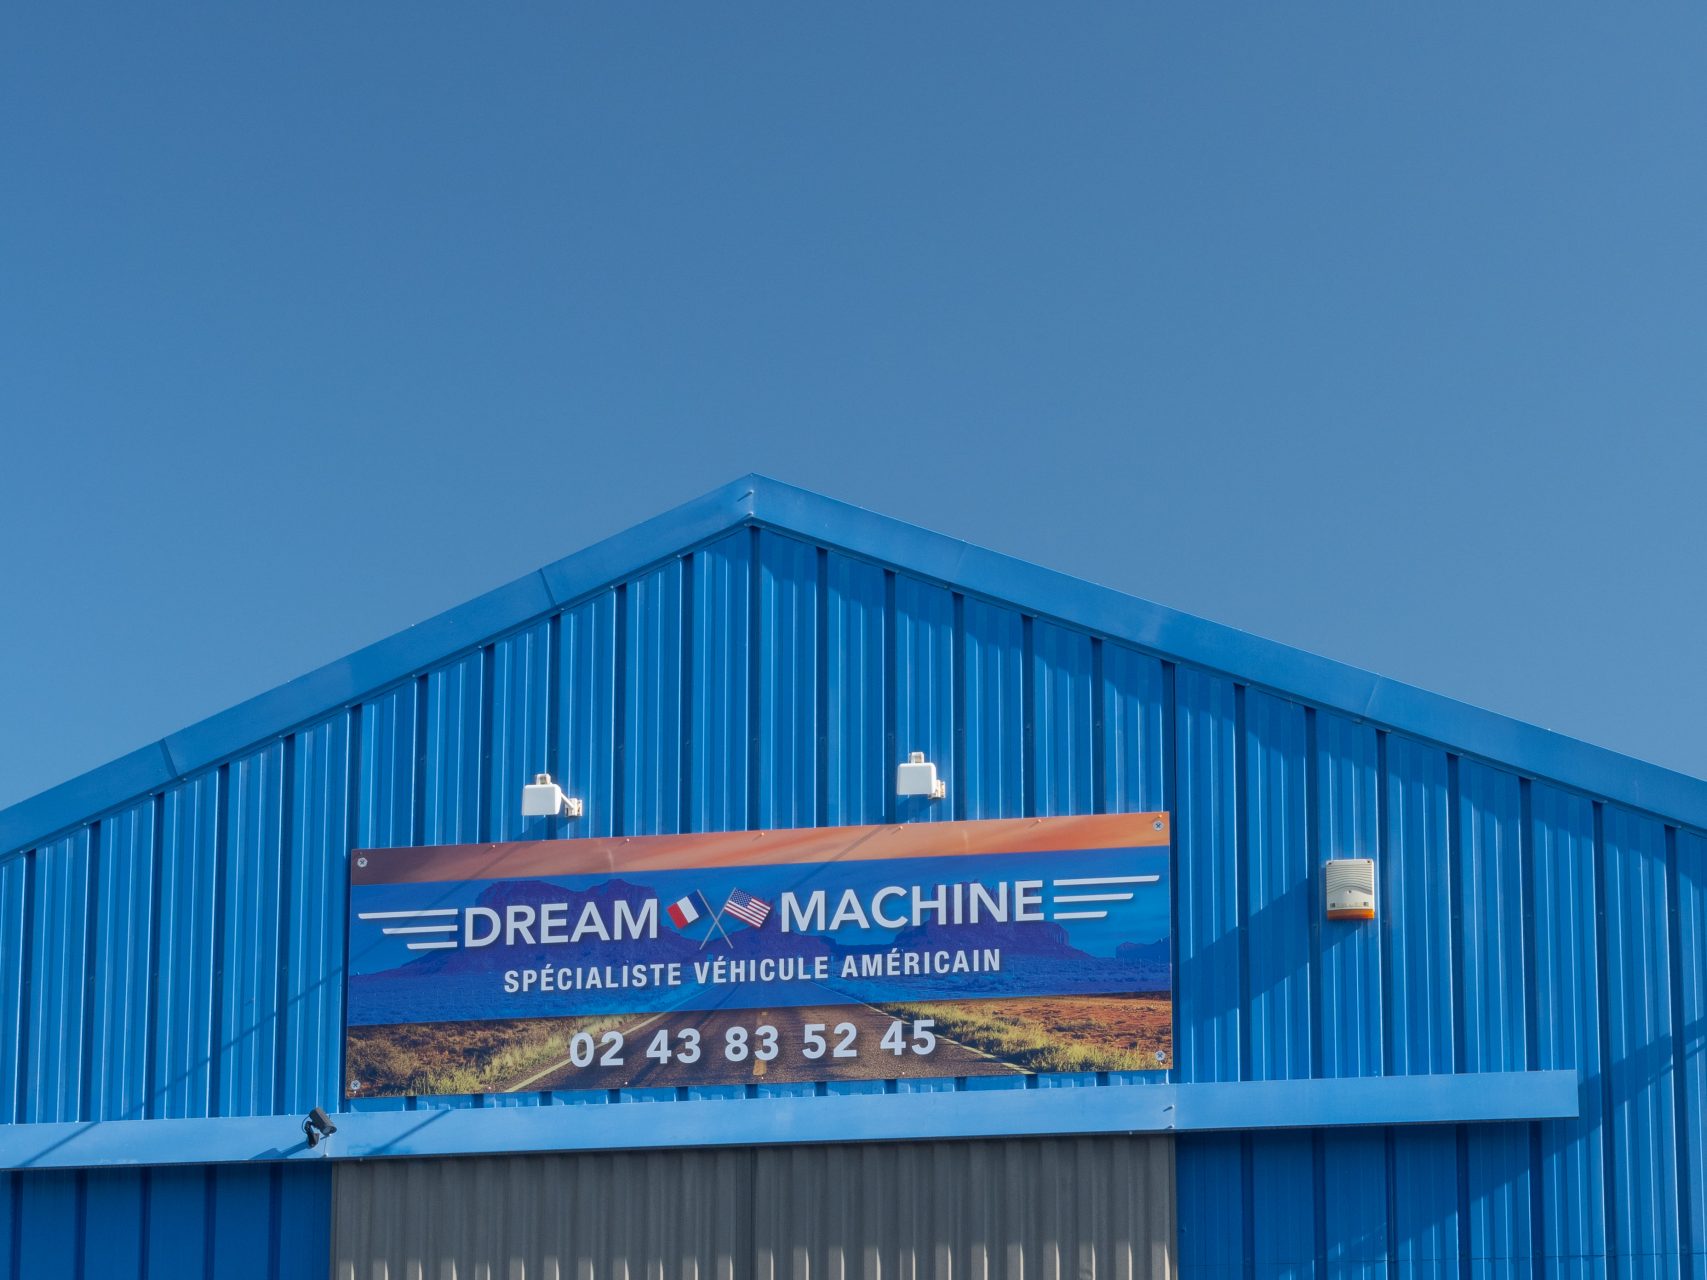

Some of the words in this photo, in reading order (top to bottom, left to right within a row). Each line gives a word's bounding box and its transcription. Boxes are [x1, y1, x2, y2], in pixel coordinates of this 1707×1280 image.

[465, 898, 658, 947] DREAM
[781, 879, 1045, 933] MACHINE
[504, 963, 682, 993] SPÉCIALISTE
[694, 955, 829, 984] VÉHICULE
[841, 948, 1000, 978] AMÉRICAIN
[569, 1031, 624, 1068] 02
[646, 1027, 701, 1064] 43
[724, 1025, 779, 1062] 83
[802, 1022, 857, 1059] 52
[880, 1019, 936, 1056] 45
